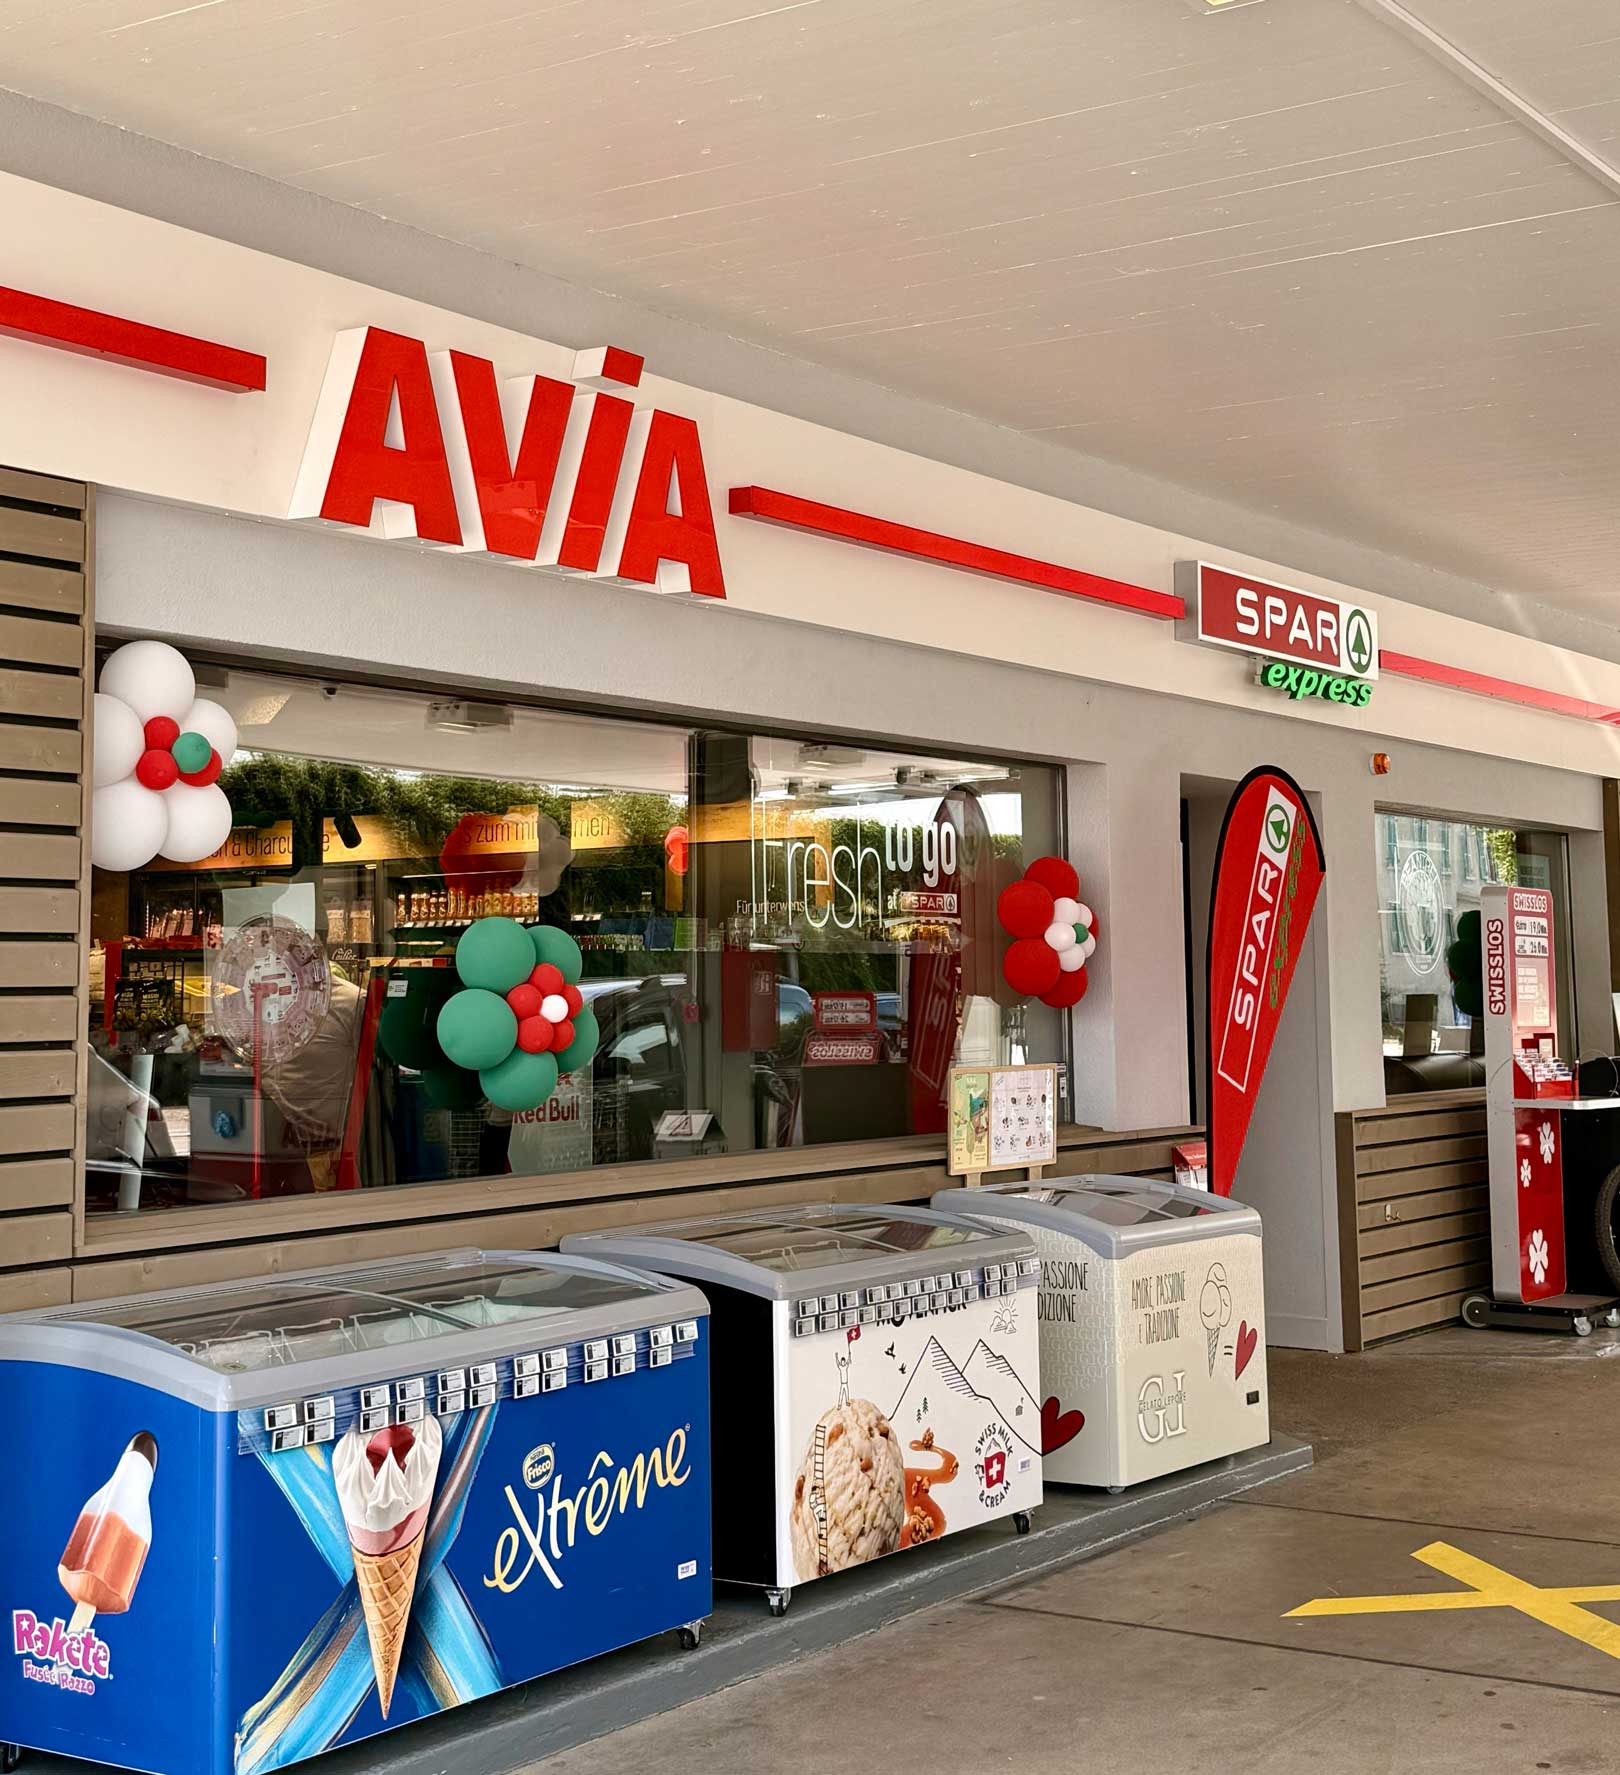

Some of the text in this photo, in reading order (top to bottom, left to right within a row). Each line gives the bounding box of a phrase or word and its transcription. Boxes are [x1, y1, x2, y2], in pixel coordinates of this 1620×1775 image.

[1235, 587, 1339, 657] SPAR
[1265, 663, 1374, 707] express
[476, 822, 510, 843] zum
[752, 796, 883, 931] Fresh
[922, 820, 957, 888] go
[911, 894, 945, 910] SPAR
[1514, 893, 1547, 912] SWISSLOS
[1234, 861, 1279, 1032] SPAR
[1487, 919, 1505, 1014] SWISSLOS
[549, 1094, 580, 1122] Bull
[1039, 1261, 1089, 1291] ASSIONE
[1156, 1270, 1186, 1306] PASSIONE
[1144, 1307, 1180, 1345] TRADIZIONE
[975, 1422, 1014, 1457] SWISS MILK
[527, 1459, 552, 1481] Frisco
[984, 1479, 1011, 1508] CREAM
[13, 1610, 110, 1678] Rakete
[60, 1671, 96, 1695] Razzo
